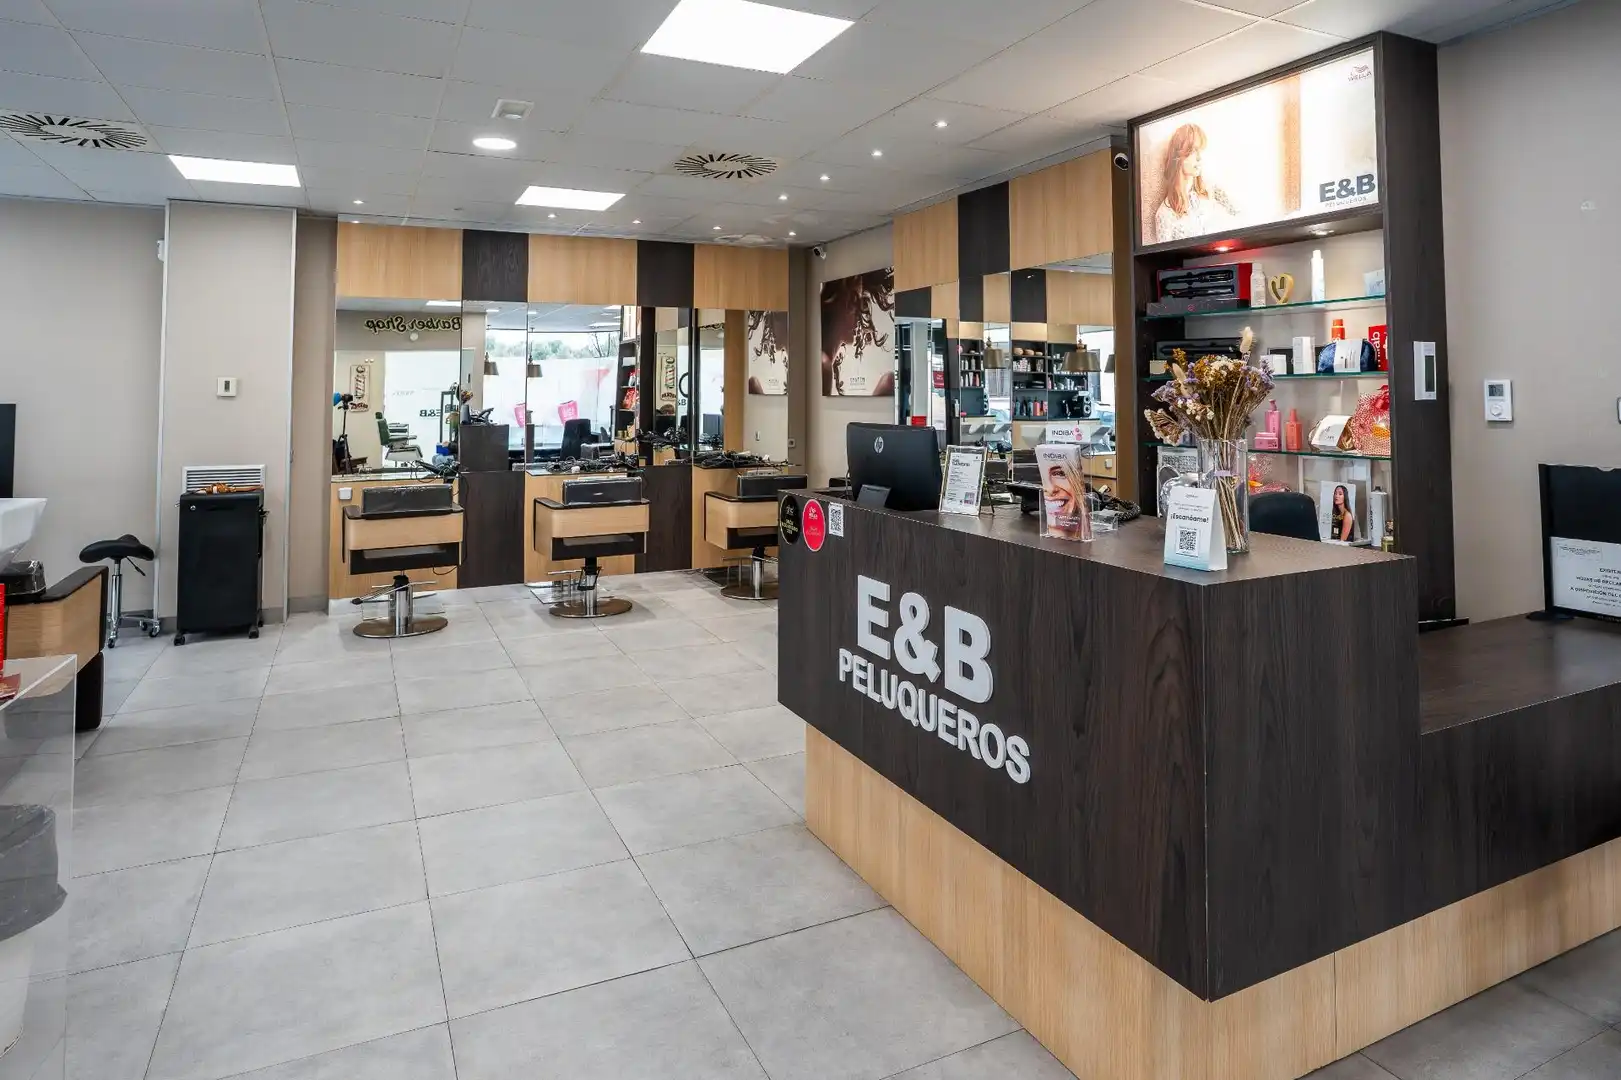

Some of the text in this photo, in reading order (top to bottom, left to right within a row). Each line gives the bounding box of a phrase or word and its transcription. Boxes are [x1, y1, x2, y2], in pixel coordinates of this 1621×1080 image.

[1319, 173, 1376, 203] E&B
[857, 574, 994, 704] E&B
[838, 648, 1031, 784] PELUQUEROS
